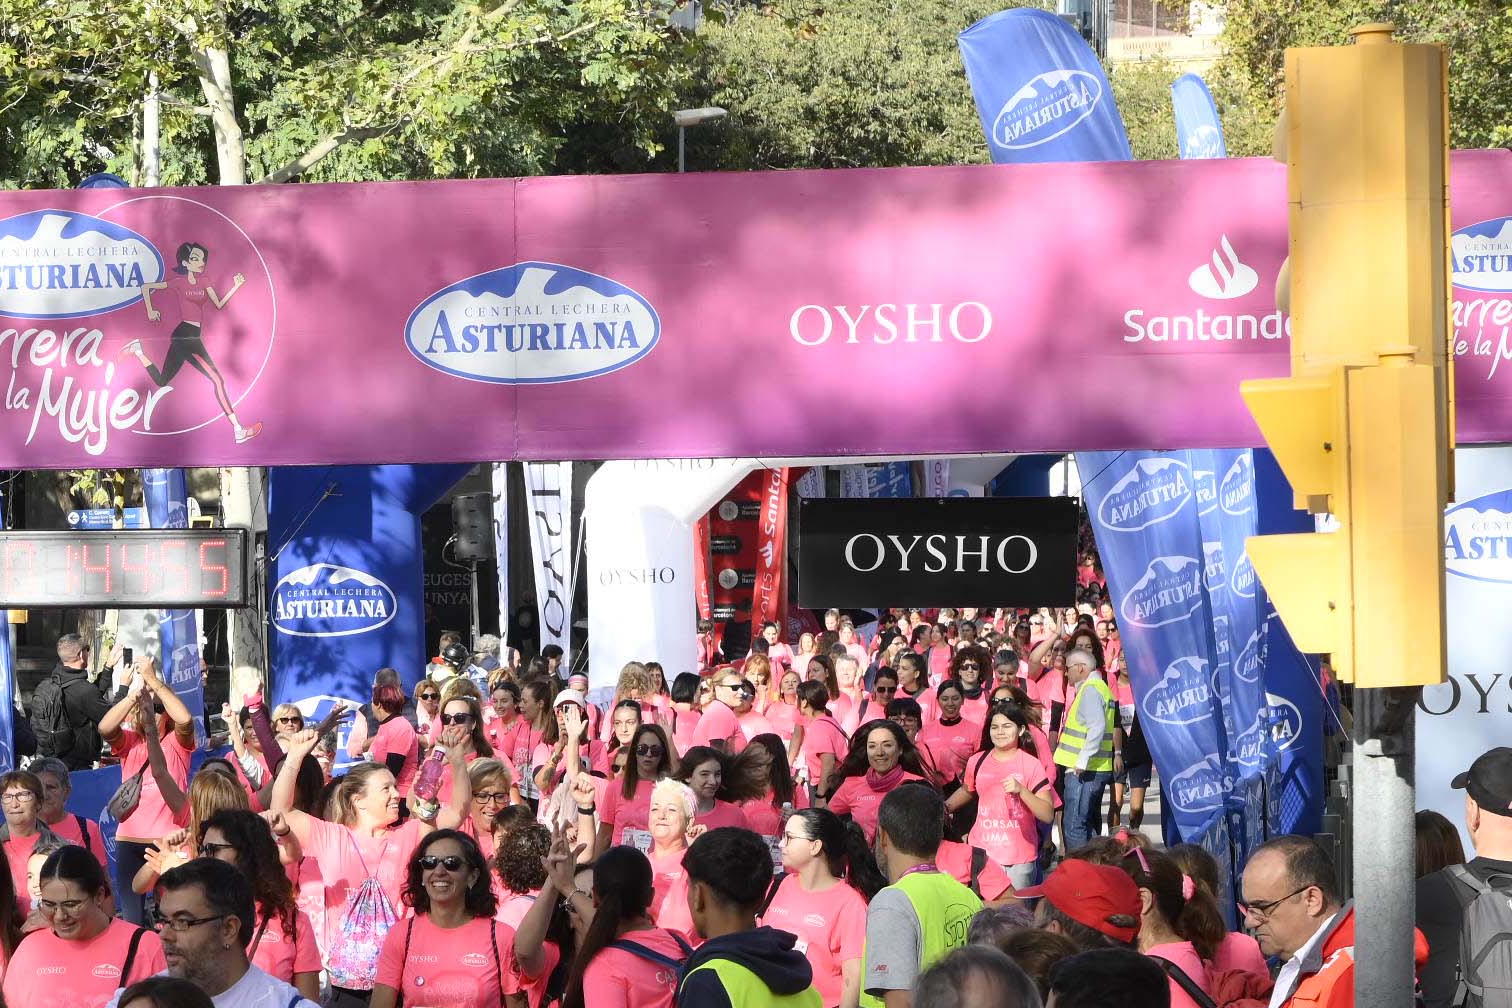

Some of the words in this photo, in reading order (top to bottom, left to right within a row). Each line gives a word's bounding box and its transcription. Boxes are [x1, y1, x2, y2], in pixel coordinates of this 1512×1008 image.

[465, 305, 542, 317] CENTRAL
[551, 304, 631, 315] LECHERA
[789, 301, 992, 346] OYSHO
[425, 310, 640, 353] ASTURIANA
[5, 371, 30, 410] la
[25, 361, 174, 456] Mujer
[845, 533, 1037, 574] OYSHO
[287, 588, 330, 598] CENTRAL
[334, 588, 383, 597] LECHERA
[599, 567, 675, 585] OYSHO
[276, 593, 388, 620] ASTURIANA
